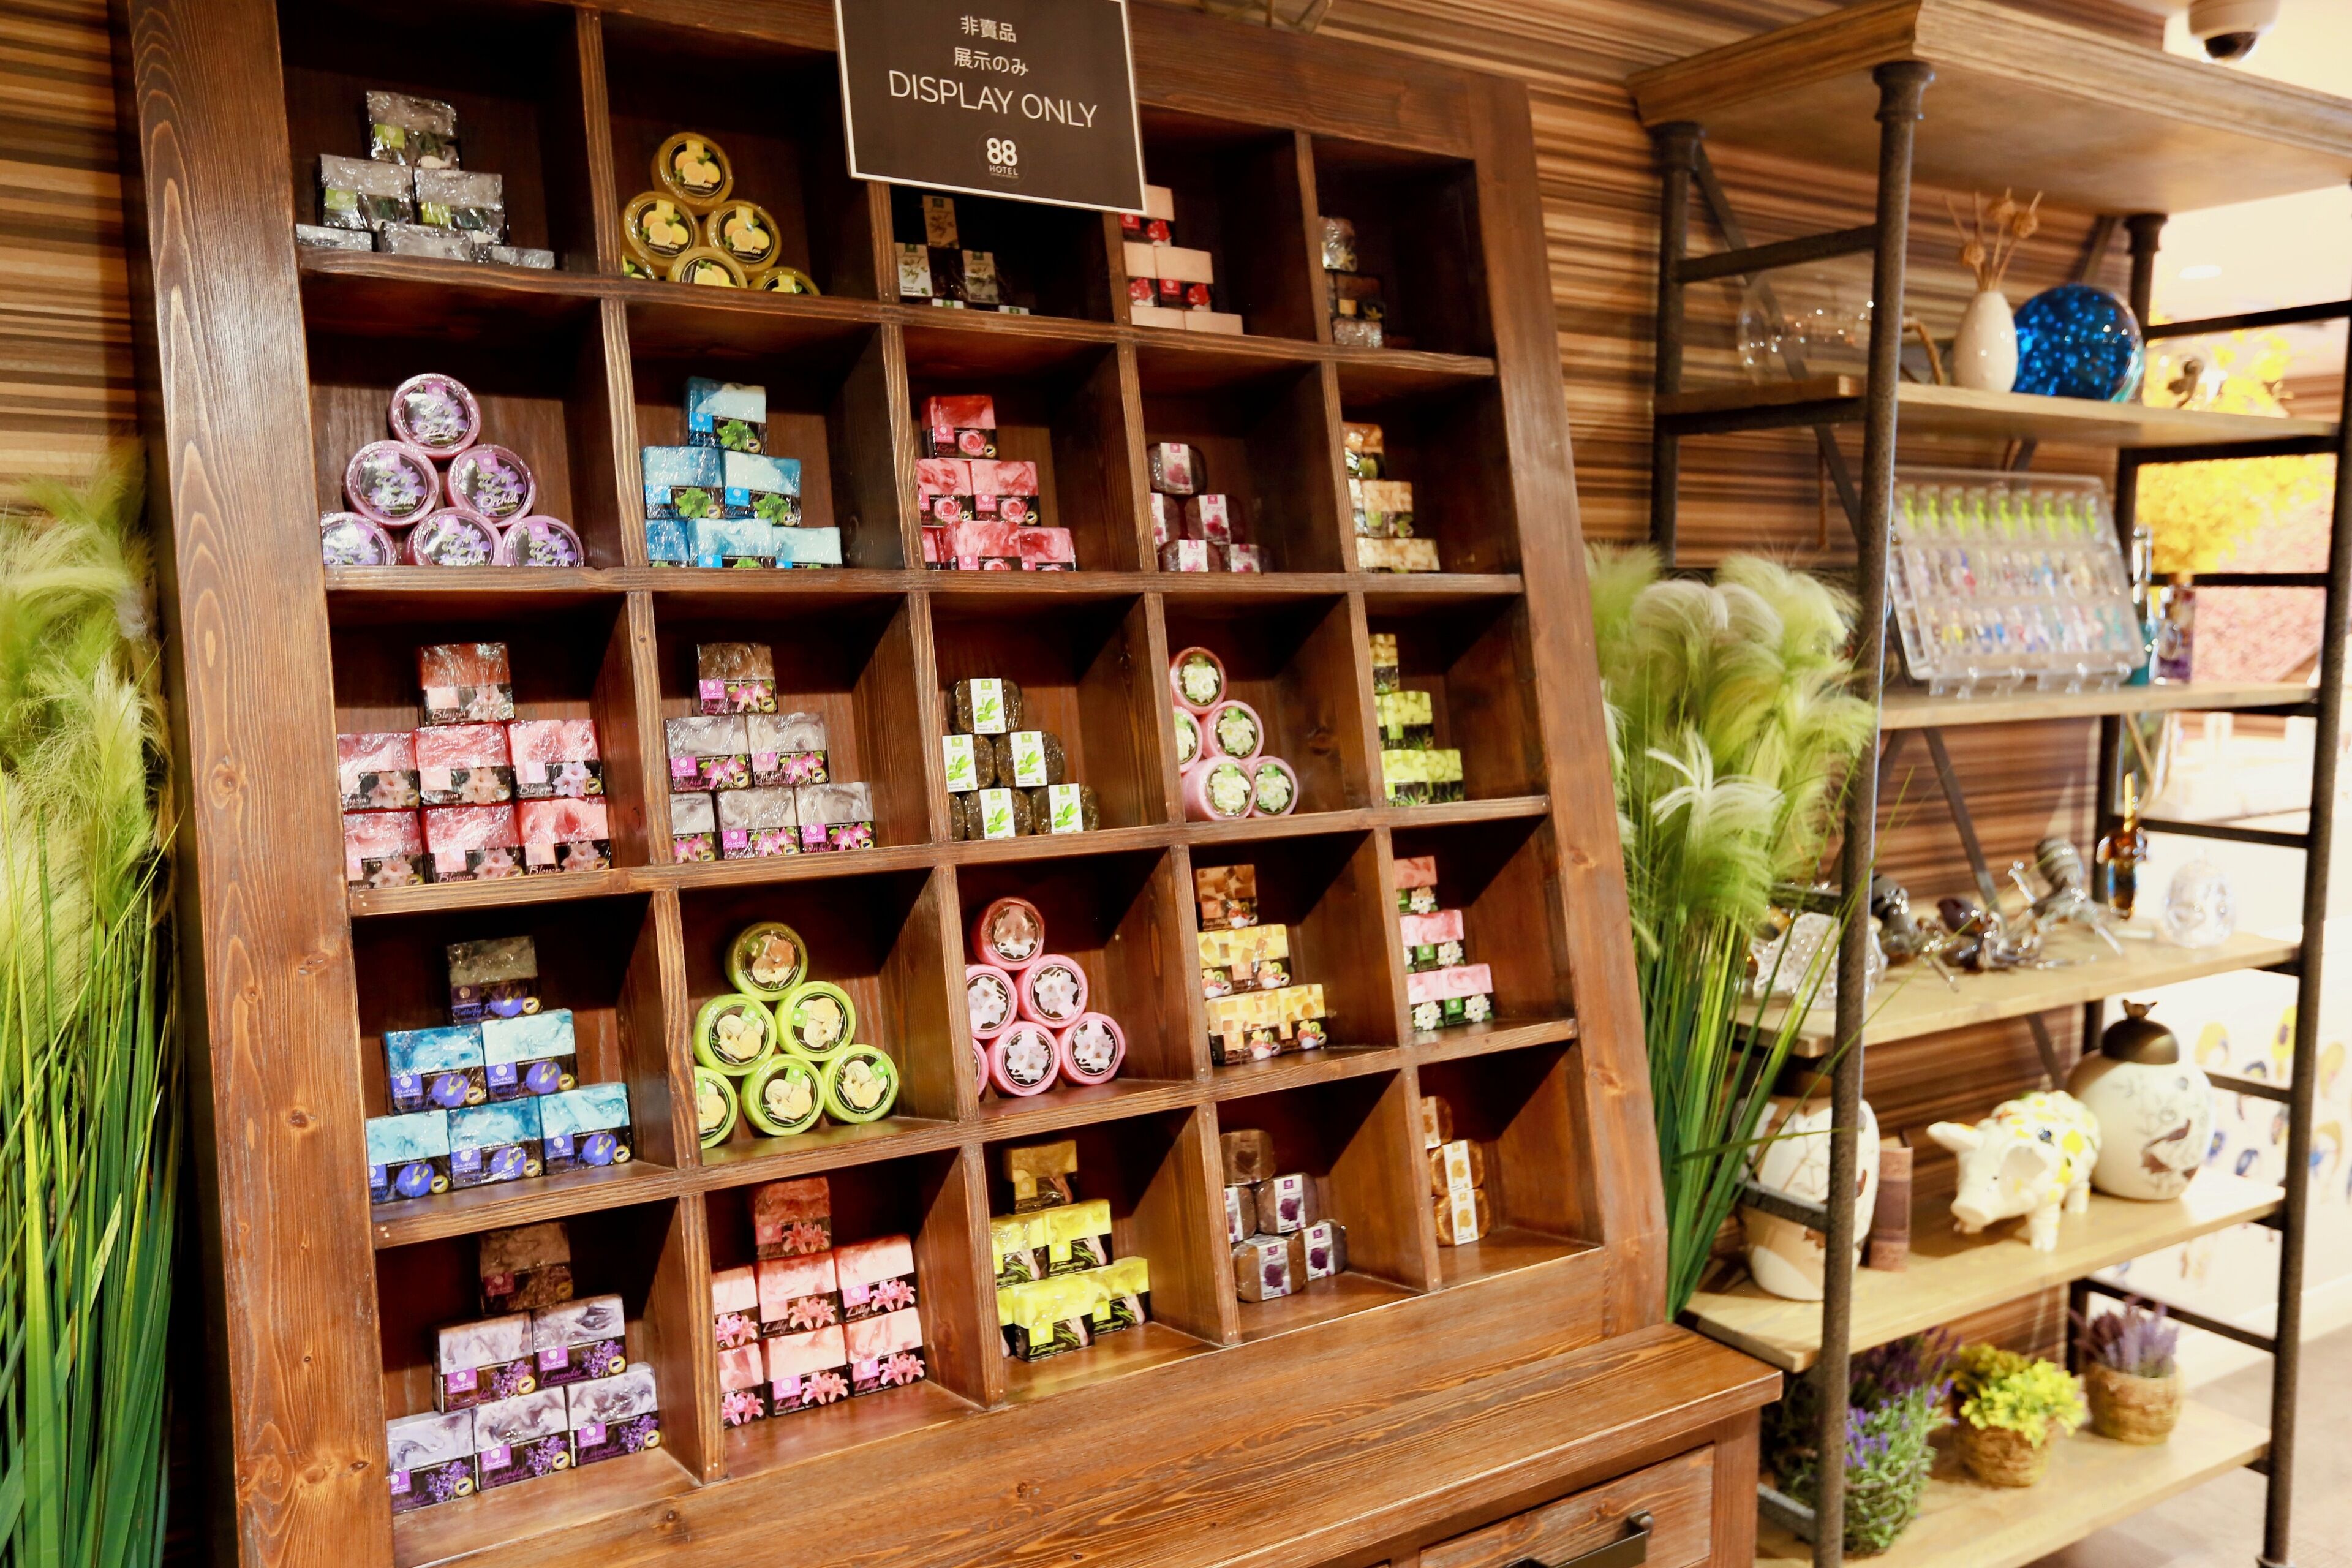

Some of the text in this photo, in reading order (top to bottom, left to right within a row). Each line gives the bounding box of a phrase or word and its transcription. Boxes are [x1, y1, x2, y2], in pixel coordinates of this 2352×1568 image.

[960, 15, 1017, 43] 非賣品
[954, 47, 1029, 76] 展示のみ
[889, 70, 1097, 127] DISPLAY ONLY
[986, 137, 1018, 167] 88
[989, 165, 1019, 176] HOTEL
[375, 494, 417, 506] Orchid
[480, 492, 519, 508] Orchid
[439, 873, 474, 883] Blossom
[529, 865, 562, 875] Blossom
[846, 1303, 870, 1317] Lilly
[763, 1321, 789, 1334] Lilly
[541, 1366, 582, 1385] Lavender
[776, 1396, 801, 1410] Lilly
[579, 1444, 619, 1460] Lavender
[482, 1468, 526, 1484] Lavender
